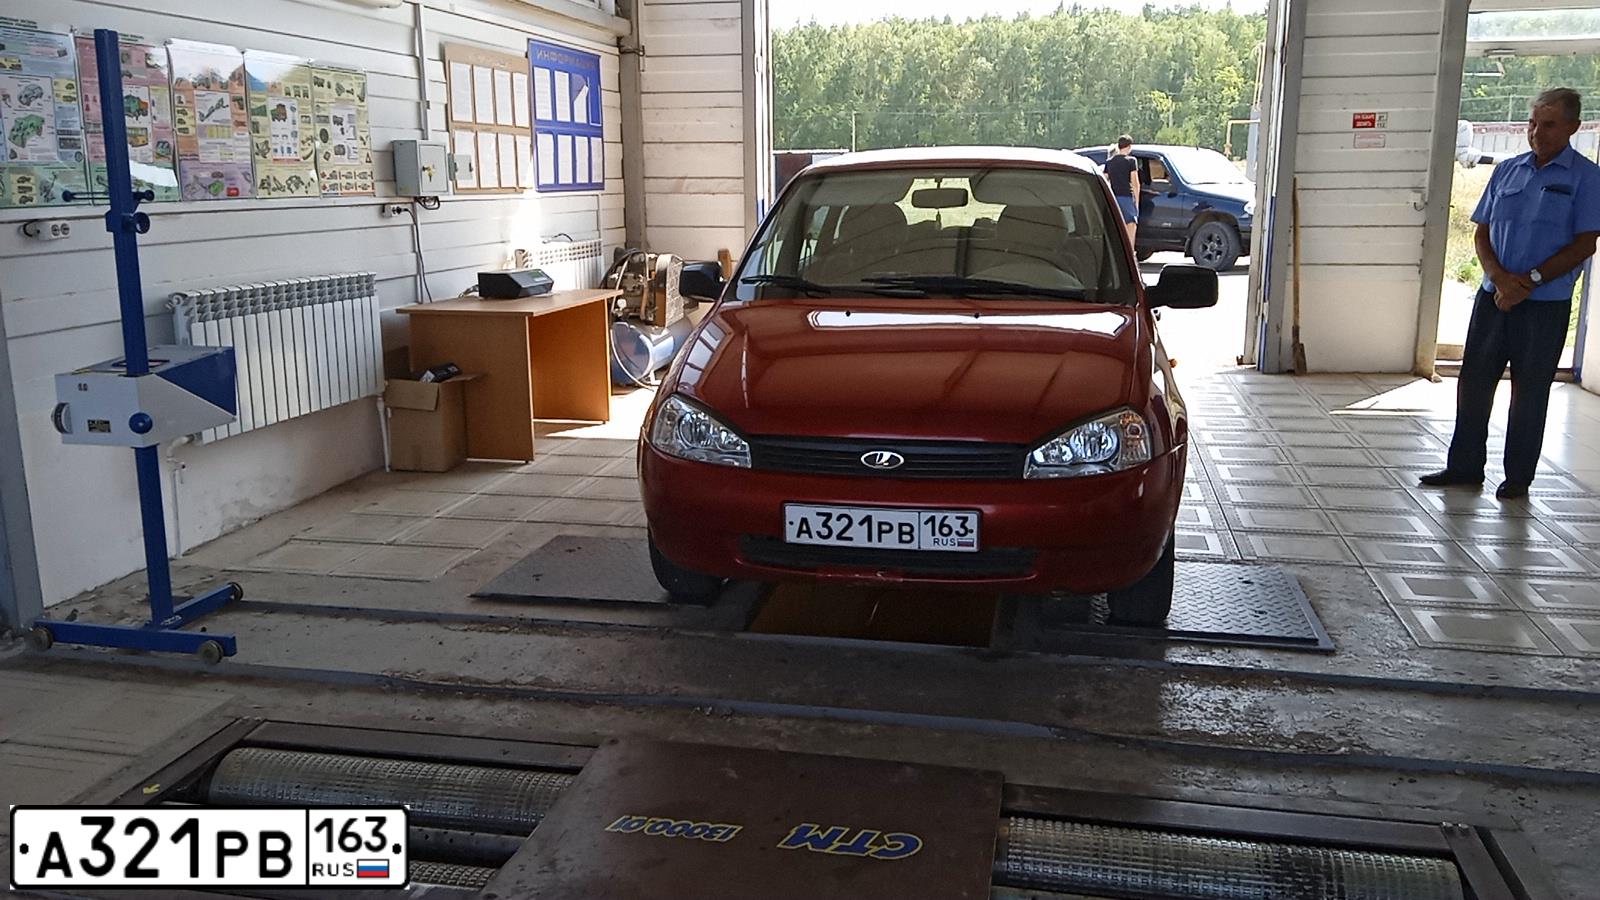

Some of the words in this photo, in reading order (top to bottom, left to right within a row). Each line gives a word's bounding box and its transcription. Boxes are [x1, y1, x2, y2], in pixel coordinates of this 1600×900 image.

[796, 512, 915, 544] А321РВ
[923, 515, 969, 538] 163
[933, 538, 956, 546] RUS
